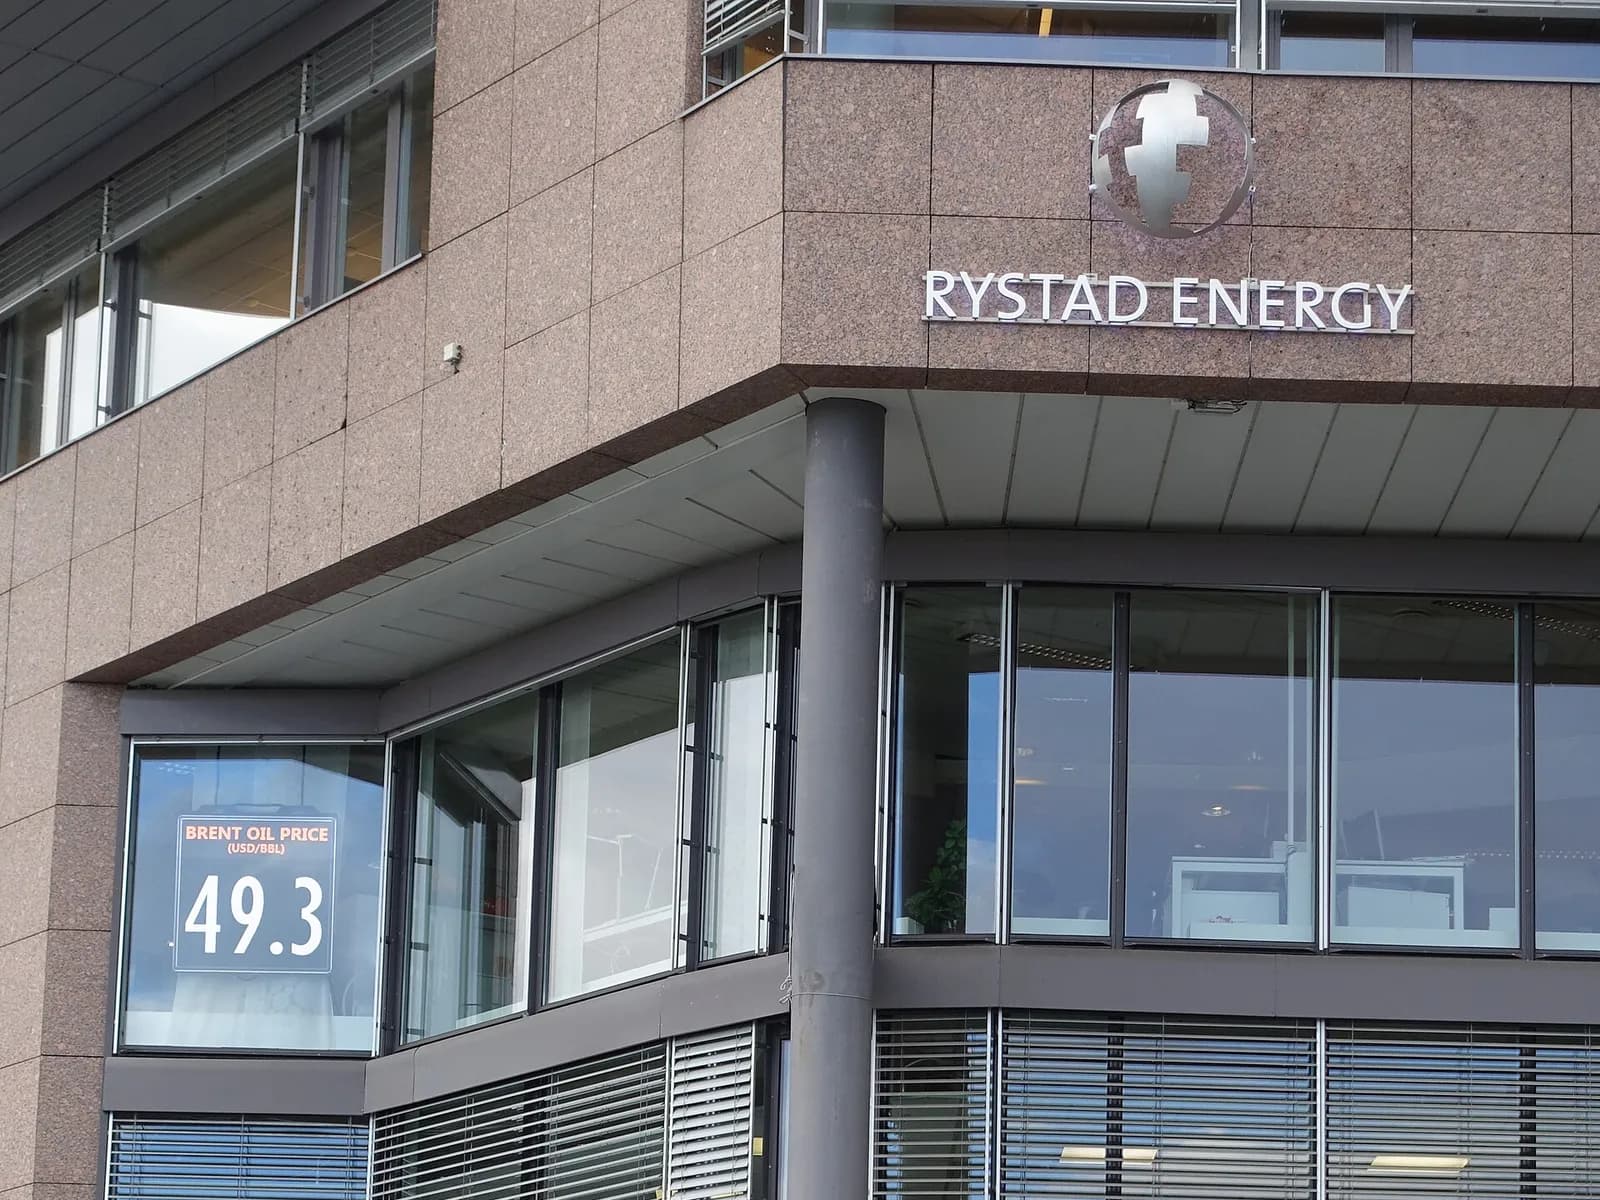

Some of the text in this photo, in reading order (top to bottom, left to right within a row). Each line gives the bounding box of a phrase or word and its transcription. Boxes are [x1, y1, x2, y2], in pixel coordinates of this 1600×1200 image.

[925, 270, 1412, 332] RYSTAD ENERGY
[185, 826, 329, 842] BRENT OIL PRICE
[227, 843, 285, 855] (USD/BBL)
[185, 875, 322, 956] 49.3
